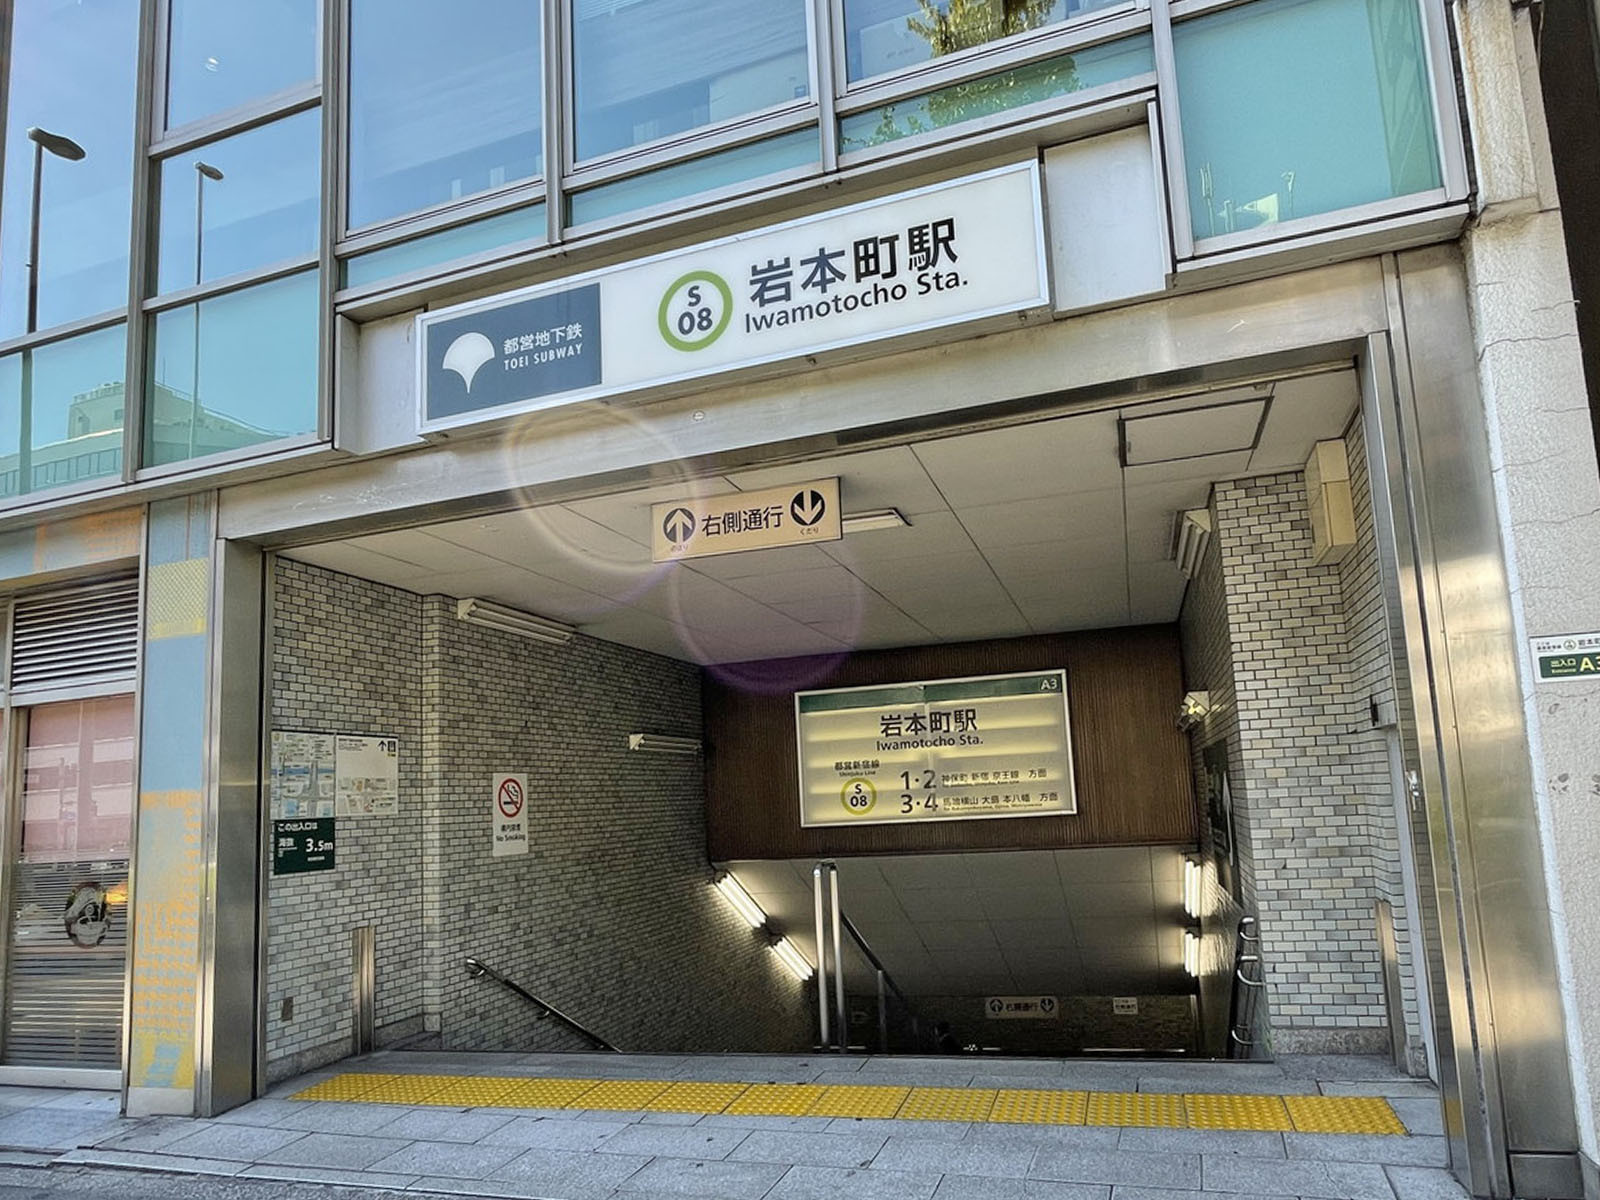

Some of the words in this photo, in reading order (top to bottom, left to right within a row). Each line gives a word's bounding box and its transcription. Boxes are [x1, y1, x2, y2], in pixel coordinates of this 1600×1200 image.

[749, 217, 959, 308] 岩本町駅
[687, 285, 702, 307] S
[745, 283, 908, 333] Iwamotocho
[917, 270, 969, 296] Sta.
[677, 307, 714, 335] 08
[503, 322, 583, 355] 都営地下鉄
[503, 355, 529, 371] TOEI
[533, 343, 583, 365] SUBWAY
[701, 505, 784, 537] 右側通行
[1040, 678, 1058, 691] A3
[880, 708, 977, 738] 岩本町駅
[876, 736, 956, 751] Iwamotocho
[959, 734, 984, 746] Sta.
[849, 795, 868, 807] 08
[854, 783, 862, 795] S
[305, 838, 334, 853] 3.5m
